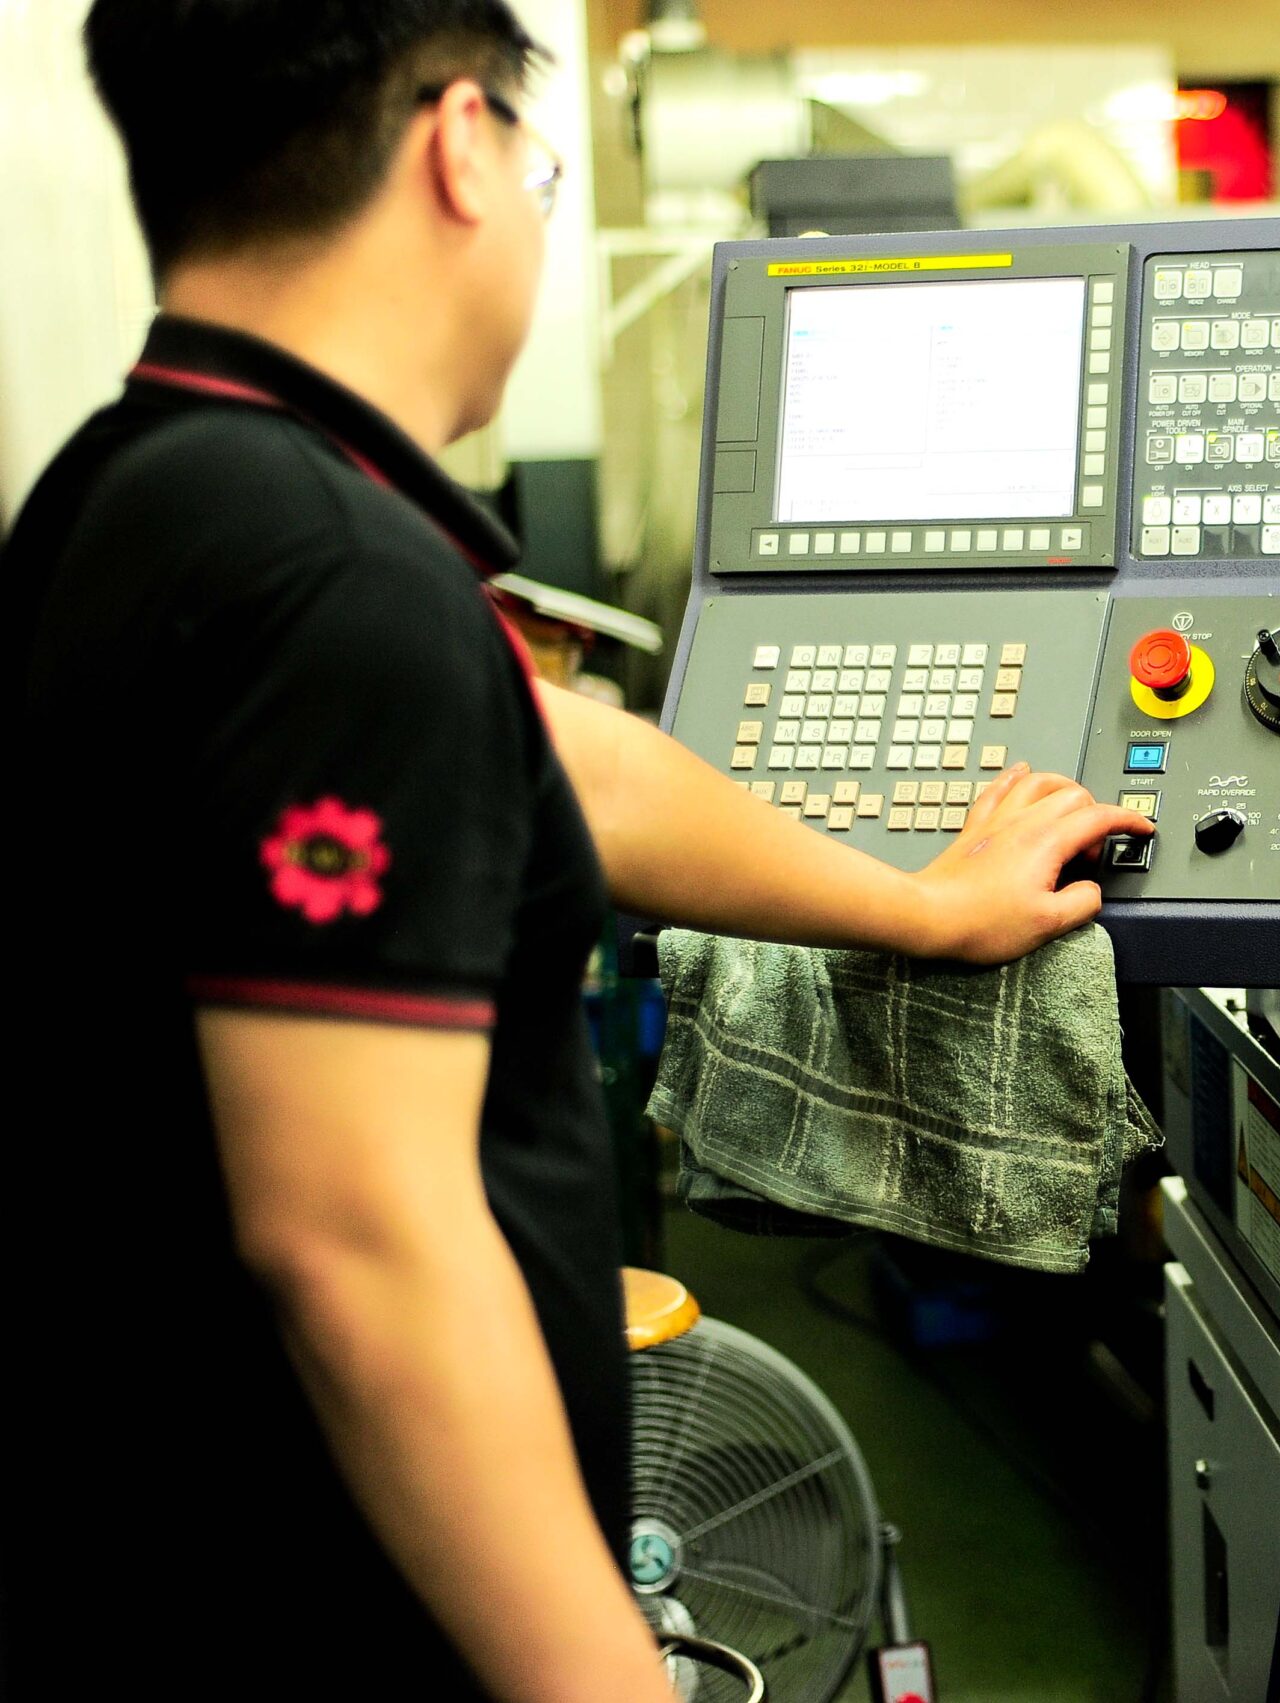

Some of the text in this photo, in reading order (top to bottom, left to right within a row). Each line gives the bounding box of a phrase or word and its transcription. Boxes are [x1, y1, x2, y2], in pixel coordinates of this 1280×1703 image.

[777, 266, 812, 274] FANUC
[816, 265, 846, 273] Series
[1152, 419, 1201, 428] POWER DRIVEN
[1227, 418, 1245, 426] MAIN
[1222, 425, 1249, 433] SPINDLE
[1244, 484, 1269, 492] SELECT
